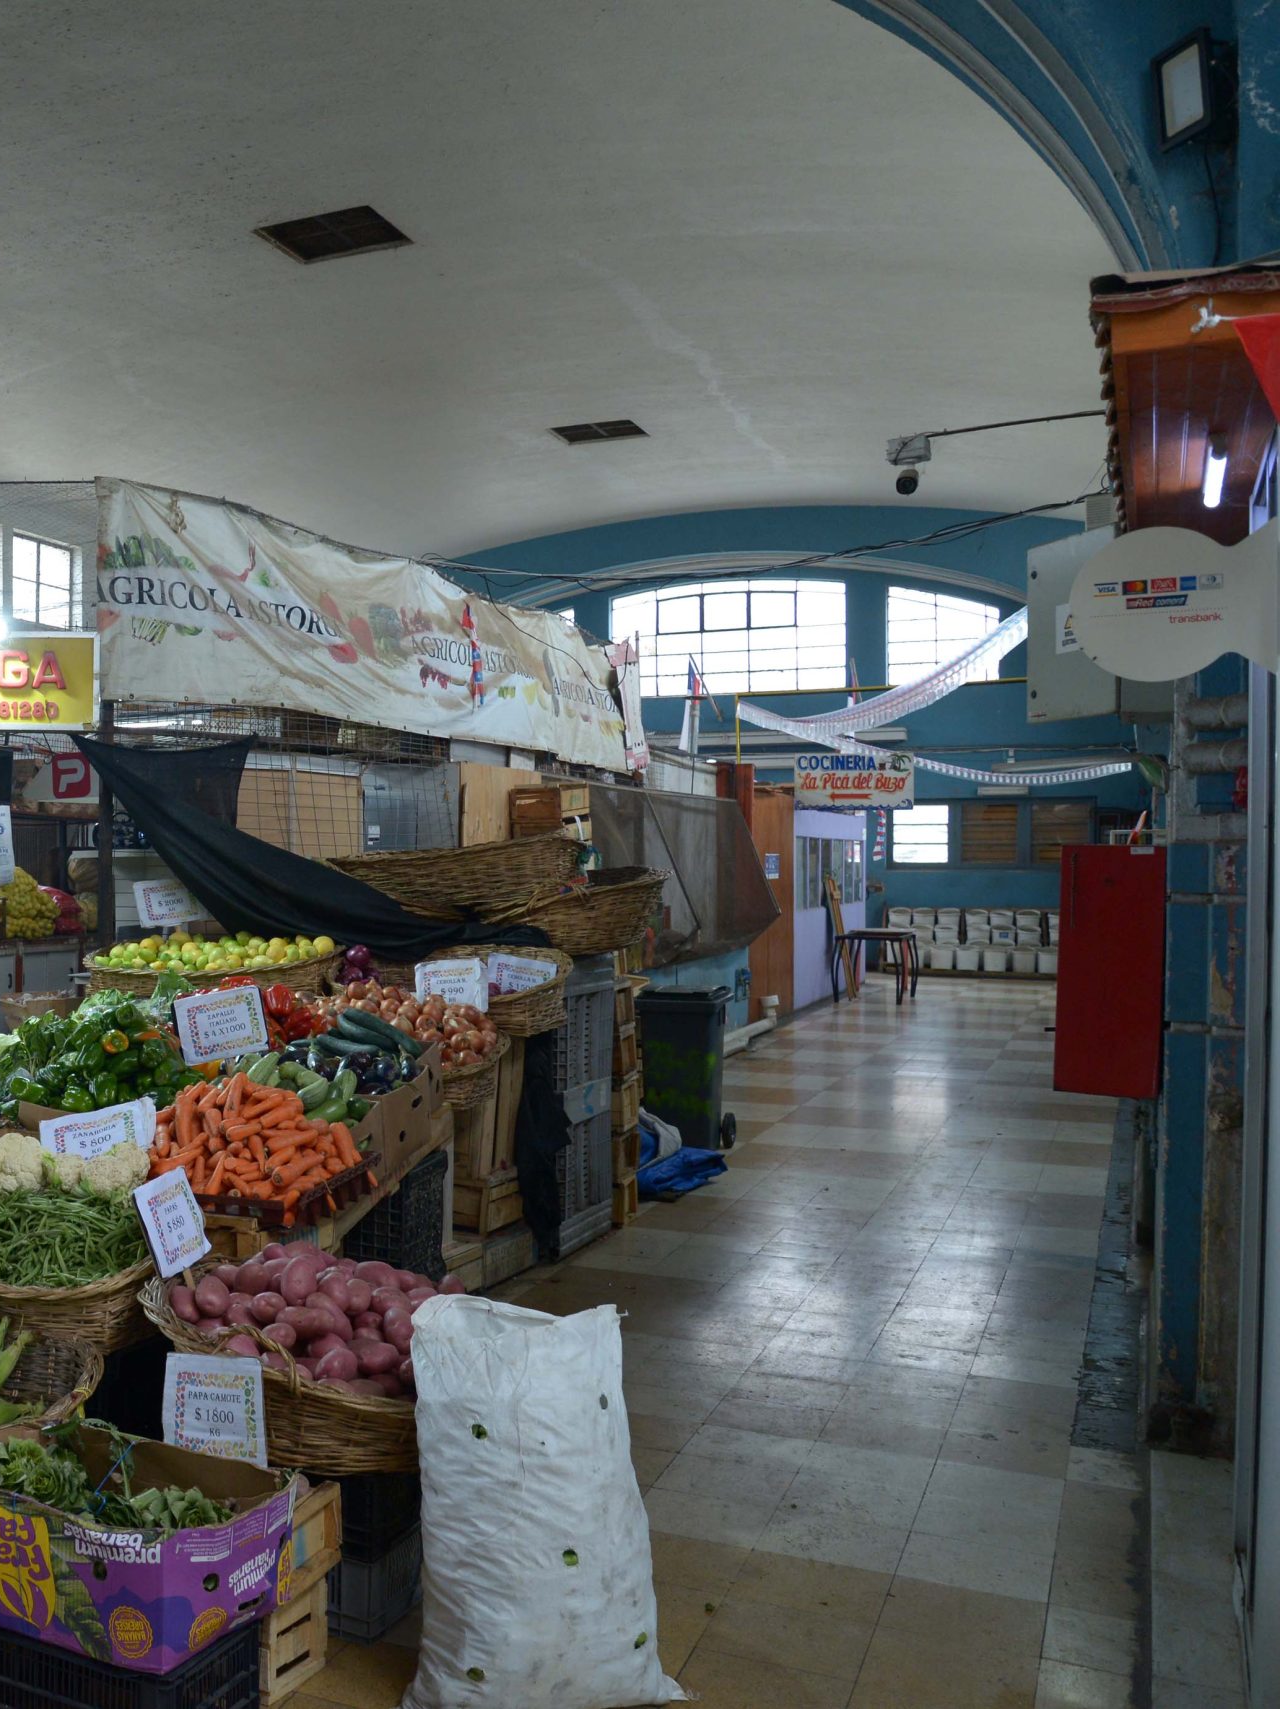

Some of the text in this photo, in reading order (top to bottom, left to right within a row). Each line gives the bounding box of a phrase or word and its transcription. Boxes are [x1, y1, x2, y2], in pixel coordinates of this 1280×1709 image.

[1097, 585, 1116, 593] VISA
[411, 635, 473, 667] AGRICOL
[797, 755, 877, 771] COCINERIA
[852, 771, 872, 790] del
[448, 987, 464, 995] 990
[207, 1009, 235, 1020] ZAPALLO
[209, 1016, 237, 1028] ITALIANO
[72, 1123, 116, 1139] ZANAHORIA
[188, 1390, 242, 1404] PAPA CAMOTE
[206, 1408, 234, 1424] 1800
[209, 1427, 221, 1437] KG
[63, 1522, 144, 1551] bananas
[74, 1538, 161, 1564] premium
[228, 1548, 270, 1588] bananas
[233, 1549, 276, 1597] premium
